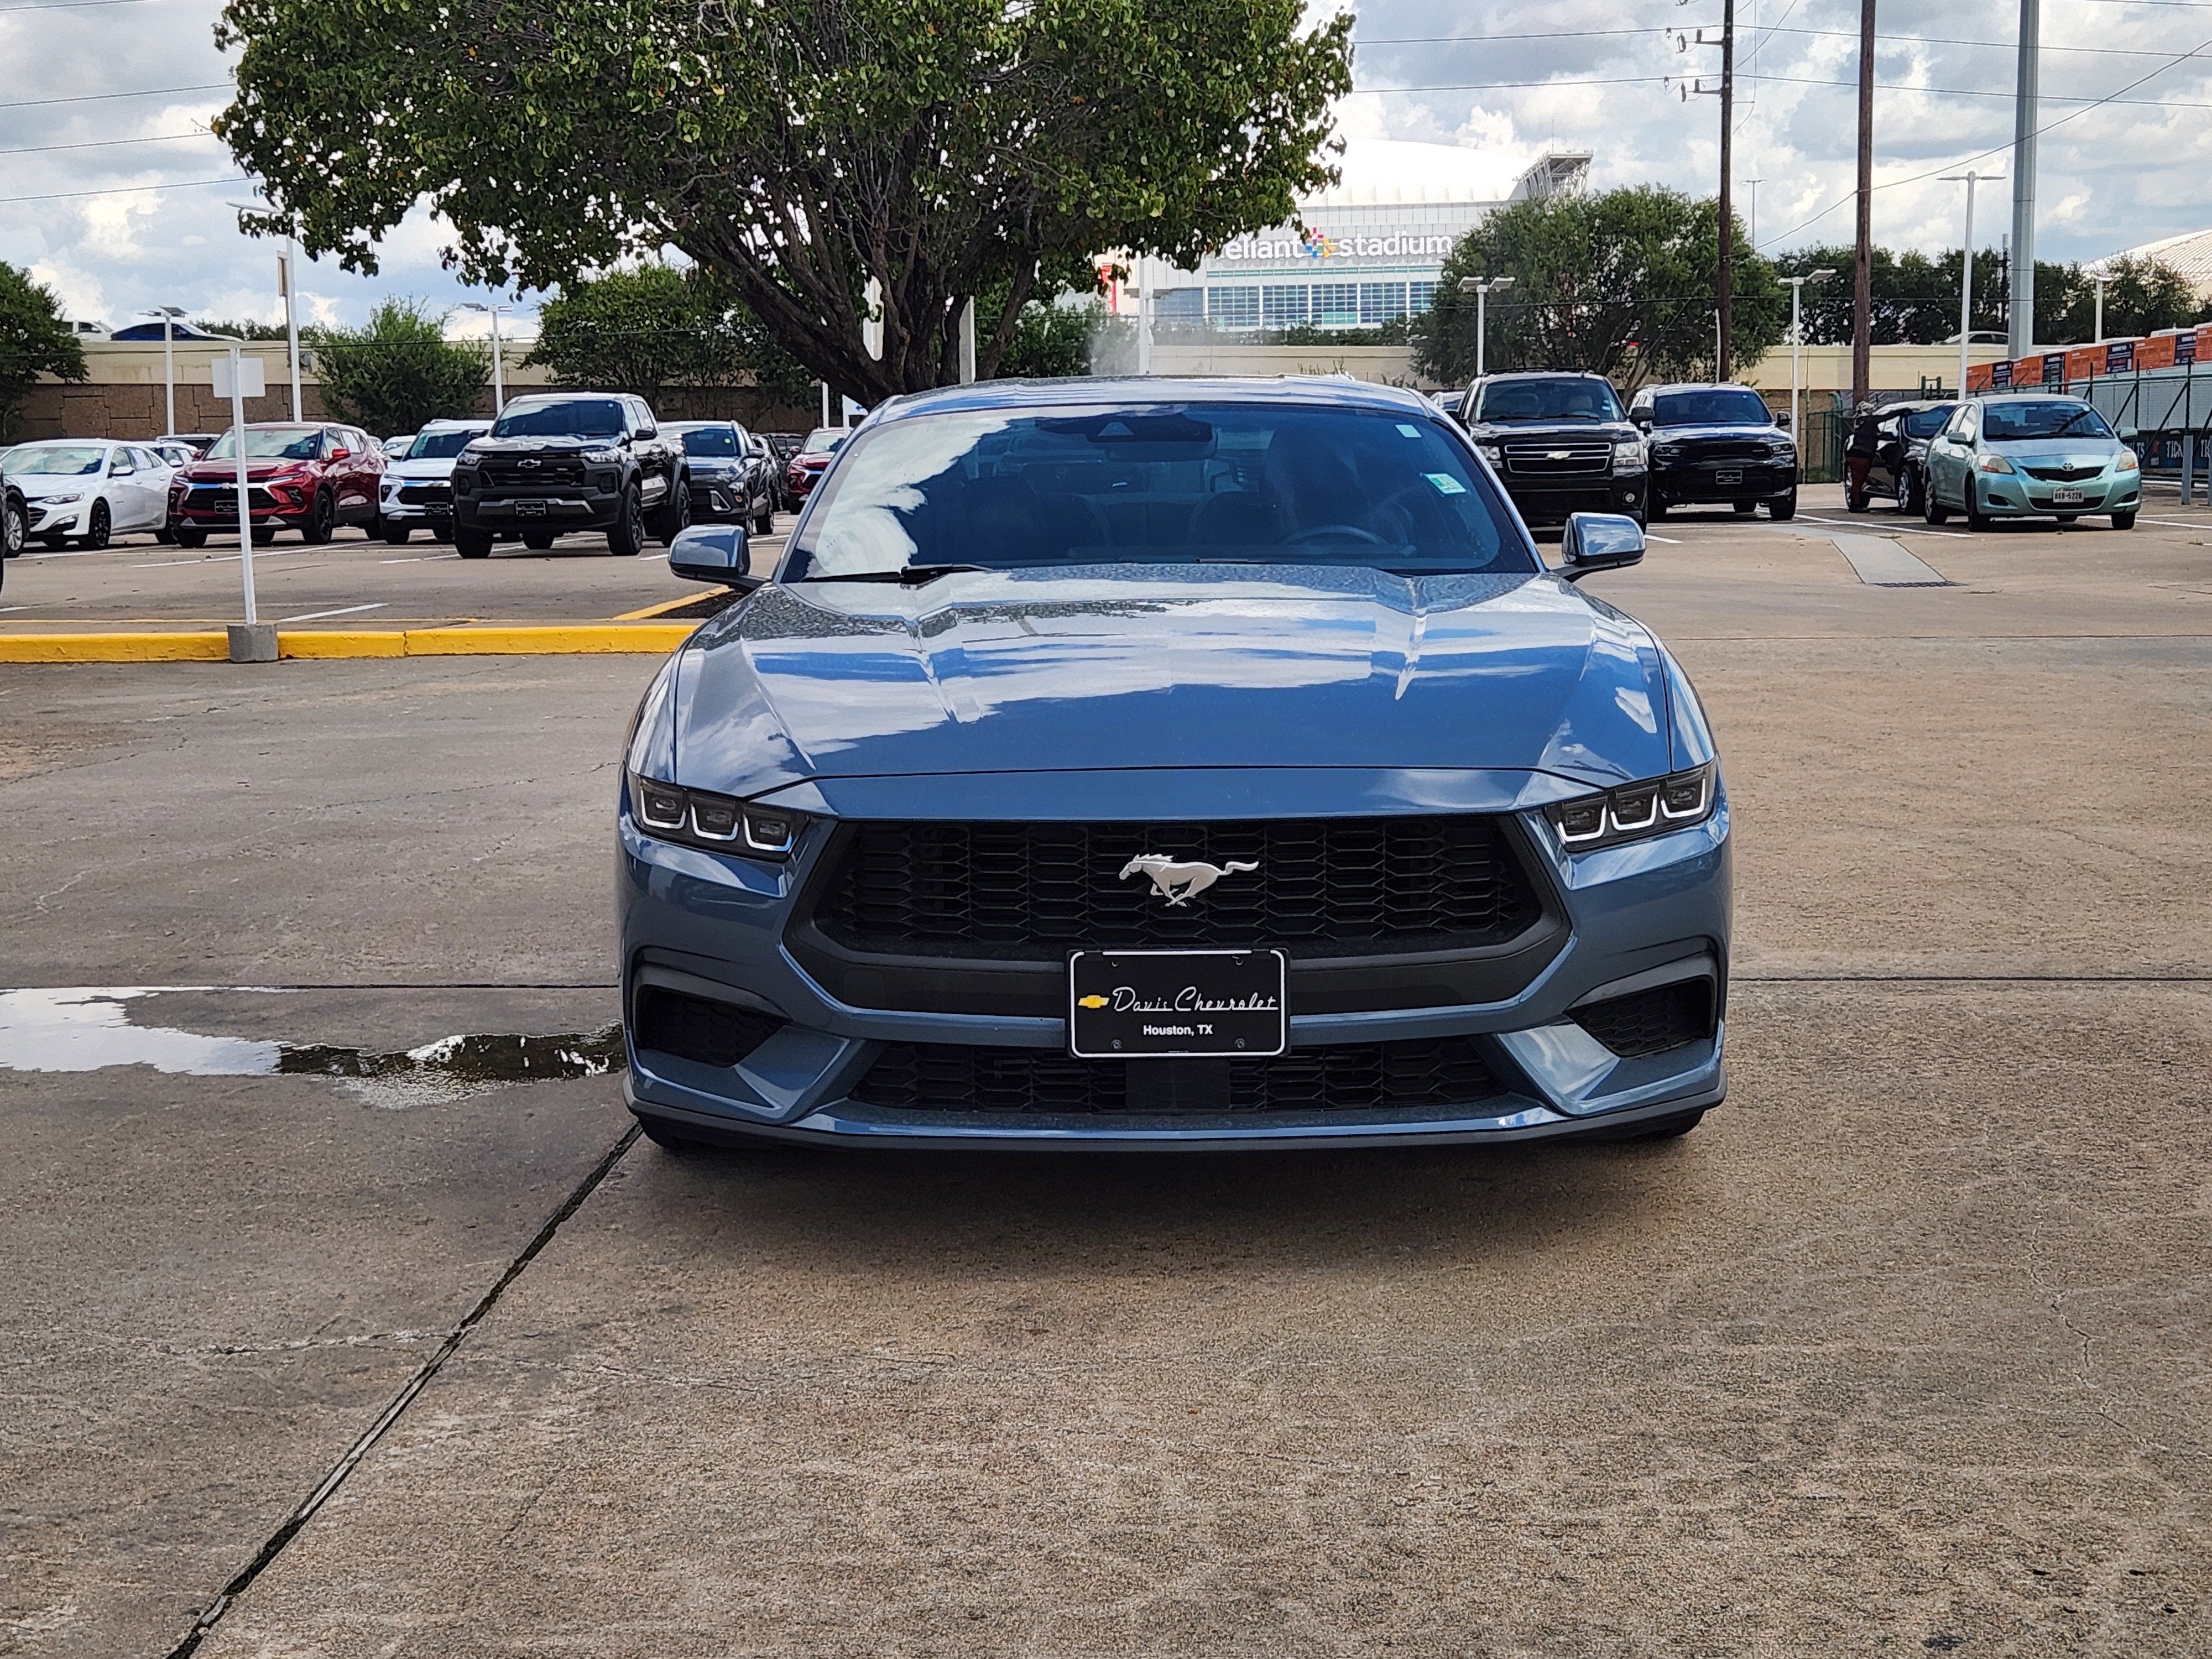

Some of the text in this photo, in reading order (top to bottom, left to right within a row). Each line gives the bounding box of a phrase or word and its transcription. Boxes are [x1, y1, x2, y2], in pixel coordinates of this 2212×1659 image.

[1221, 230, 1453, 260] eliant stadium
[1112, 986, 1279, 1012] Davis Chevrolet
[1143, 1024, 1213, 1037] Houston, TX
